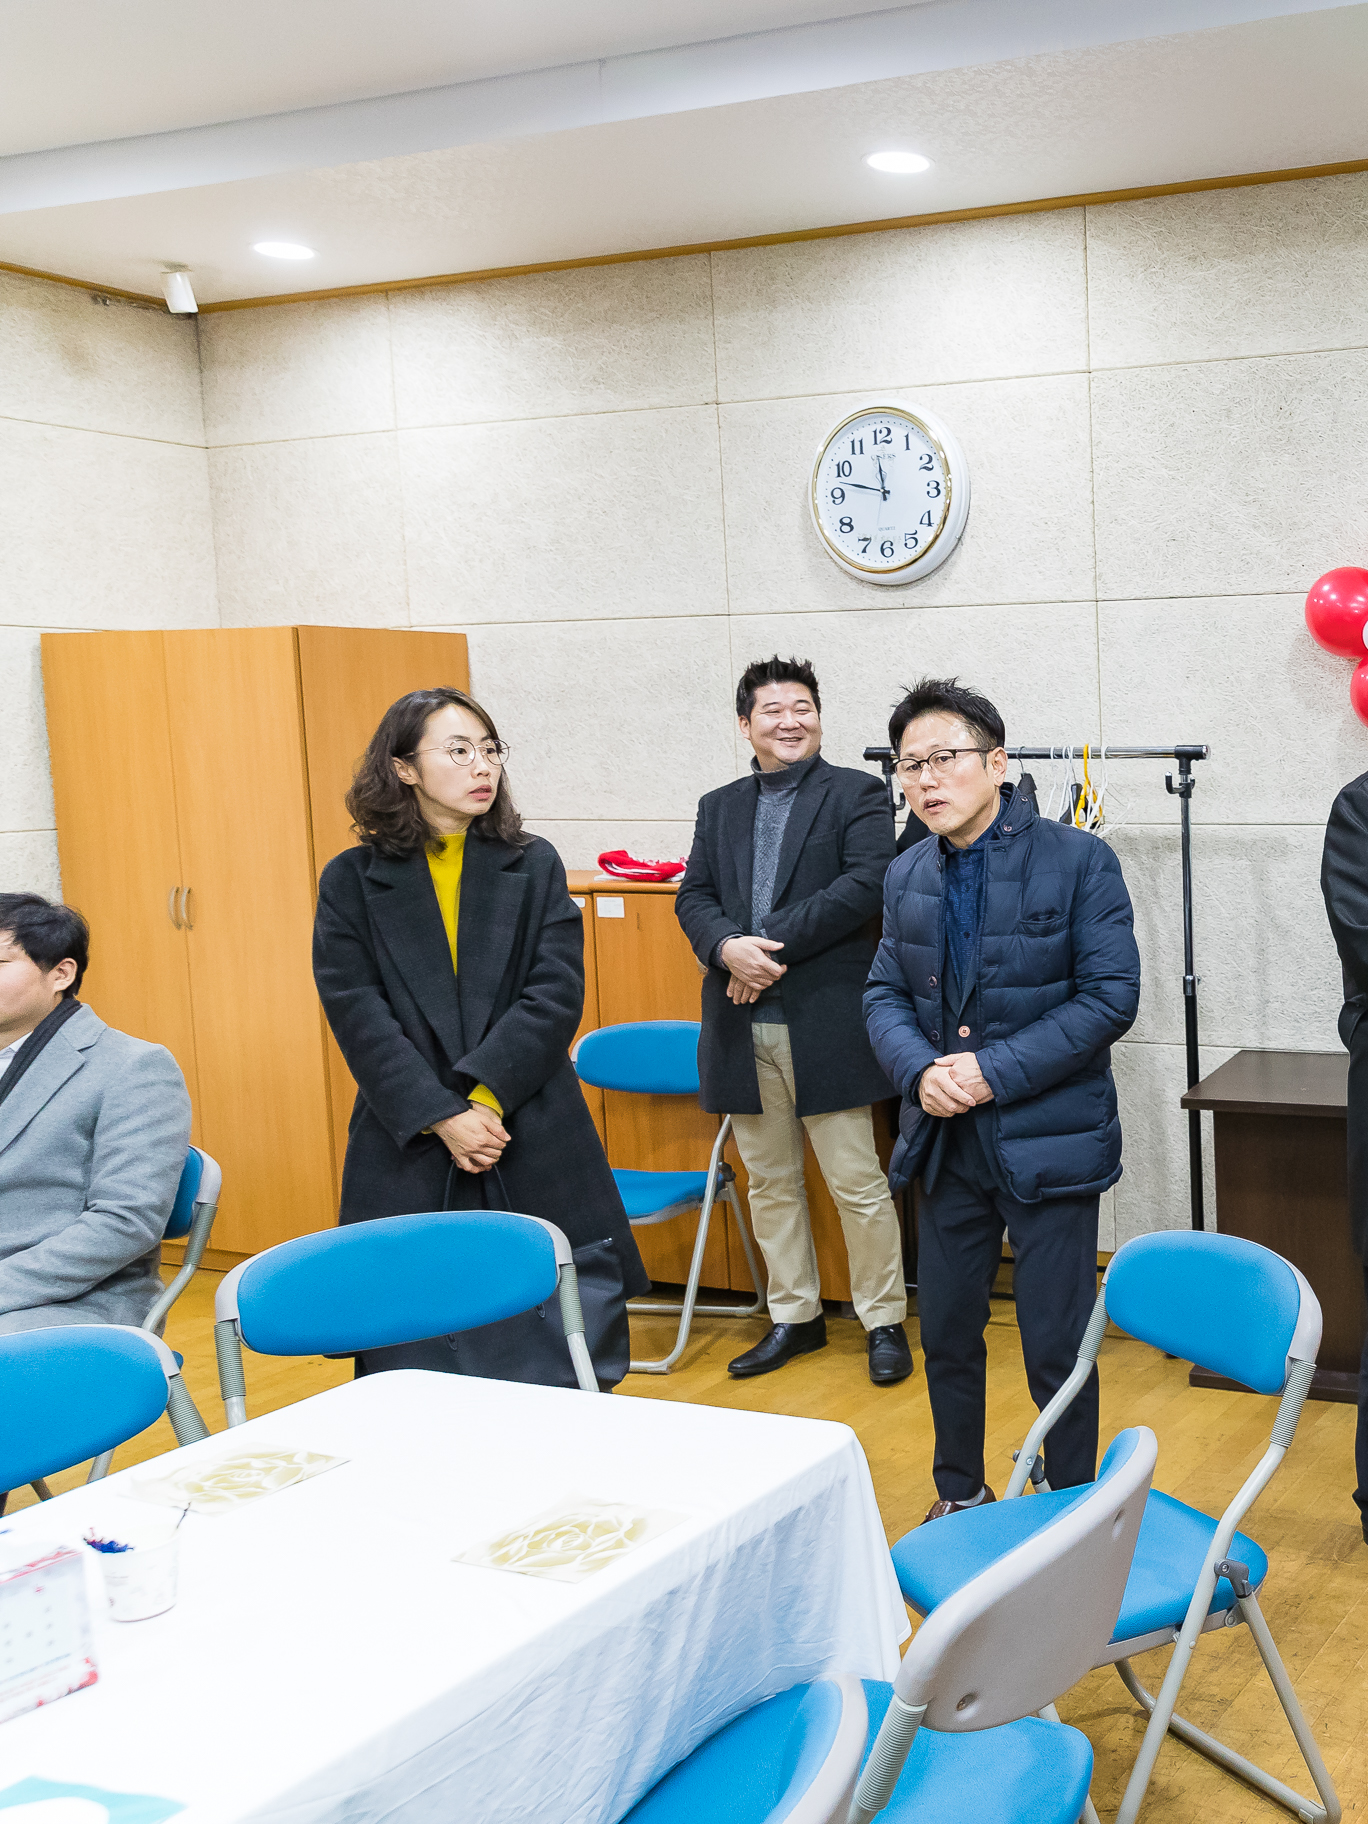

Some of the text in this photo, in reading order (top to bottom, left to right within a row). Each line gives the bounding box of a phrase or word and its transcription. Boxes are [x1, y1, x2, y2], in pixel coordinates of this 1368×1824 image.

[872, 426, 893, 445] 12
[903, 432, 911, 451] 1
[850, 437, 865, 456] 11
[835, 460, 853, 478] 10
[918, 453, 935, 472] 2
[830, 486, 846, 505] 9
[926, 480, 941, 498] 3
[838, 516, 854, 534] 8
[919, 509, 935, 527] 4
[857, 536, 872, 553] 7
[903, 529, 919, 549] 5
[880, 540, 895, 558] 6
